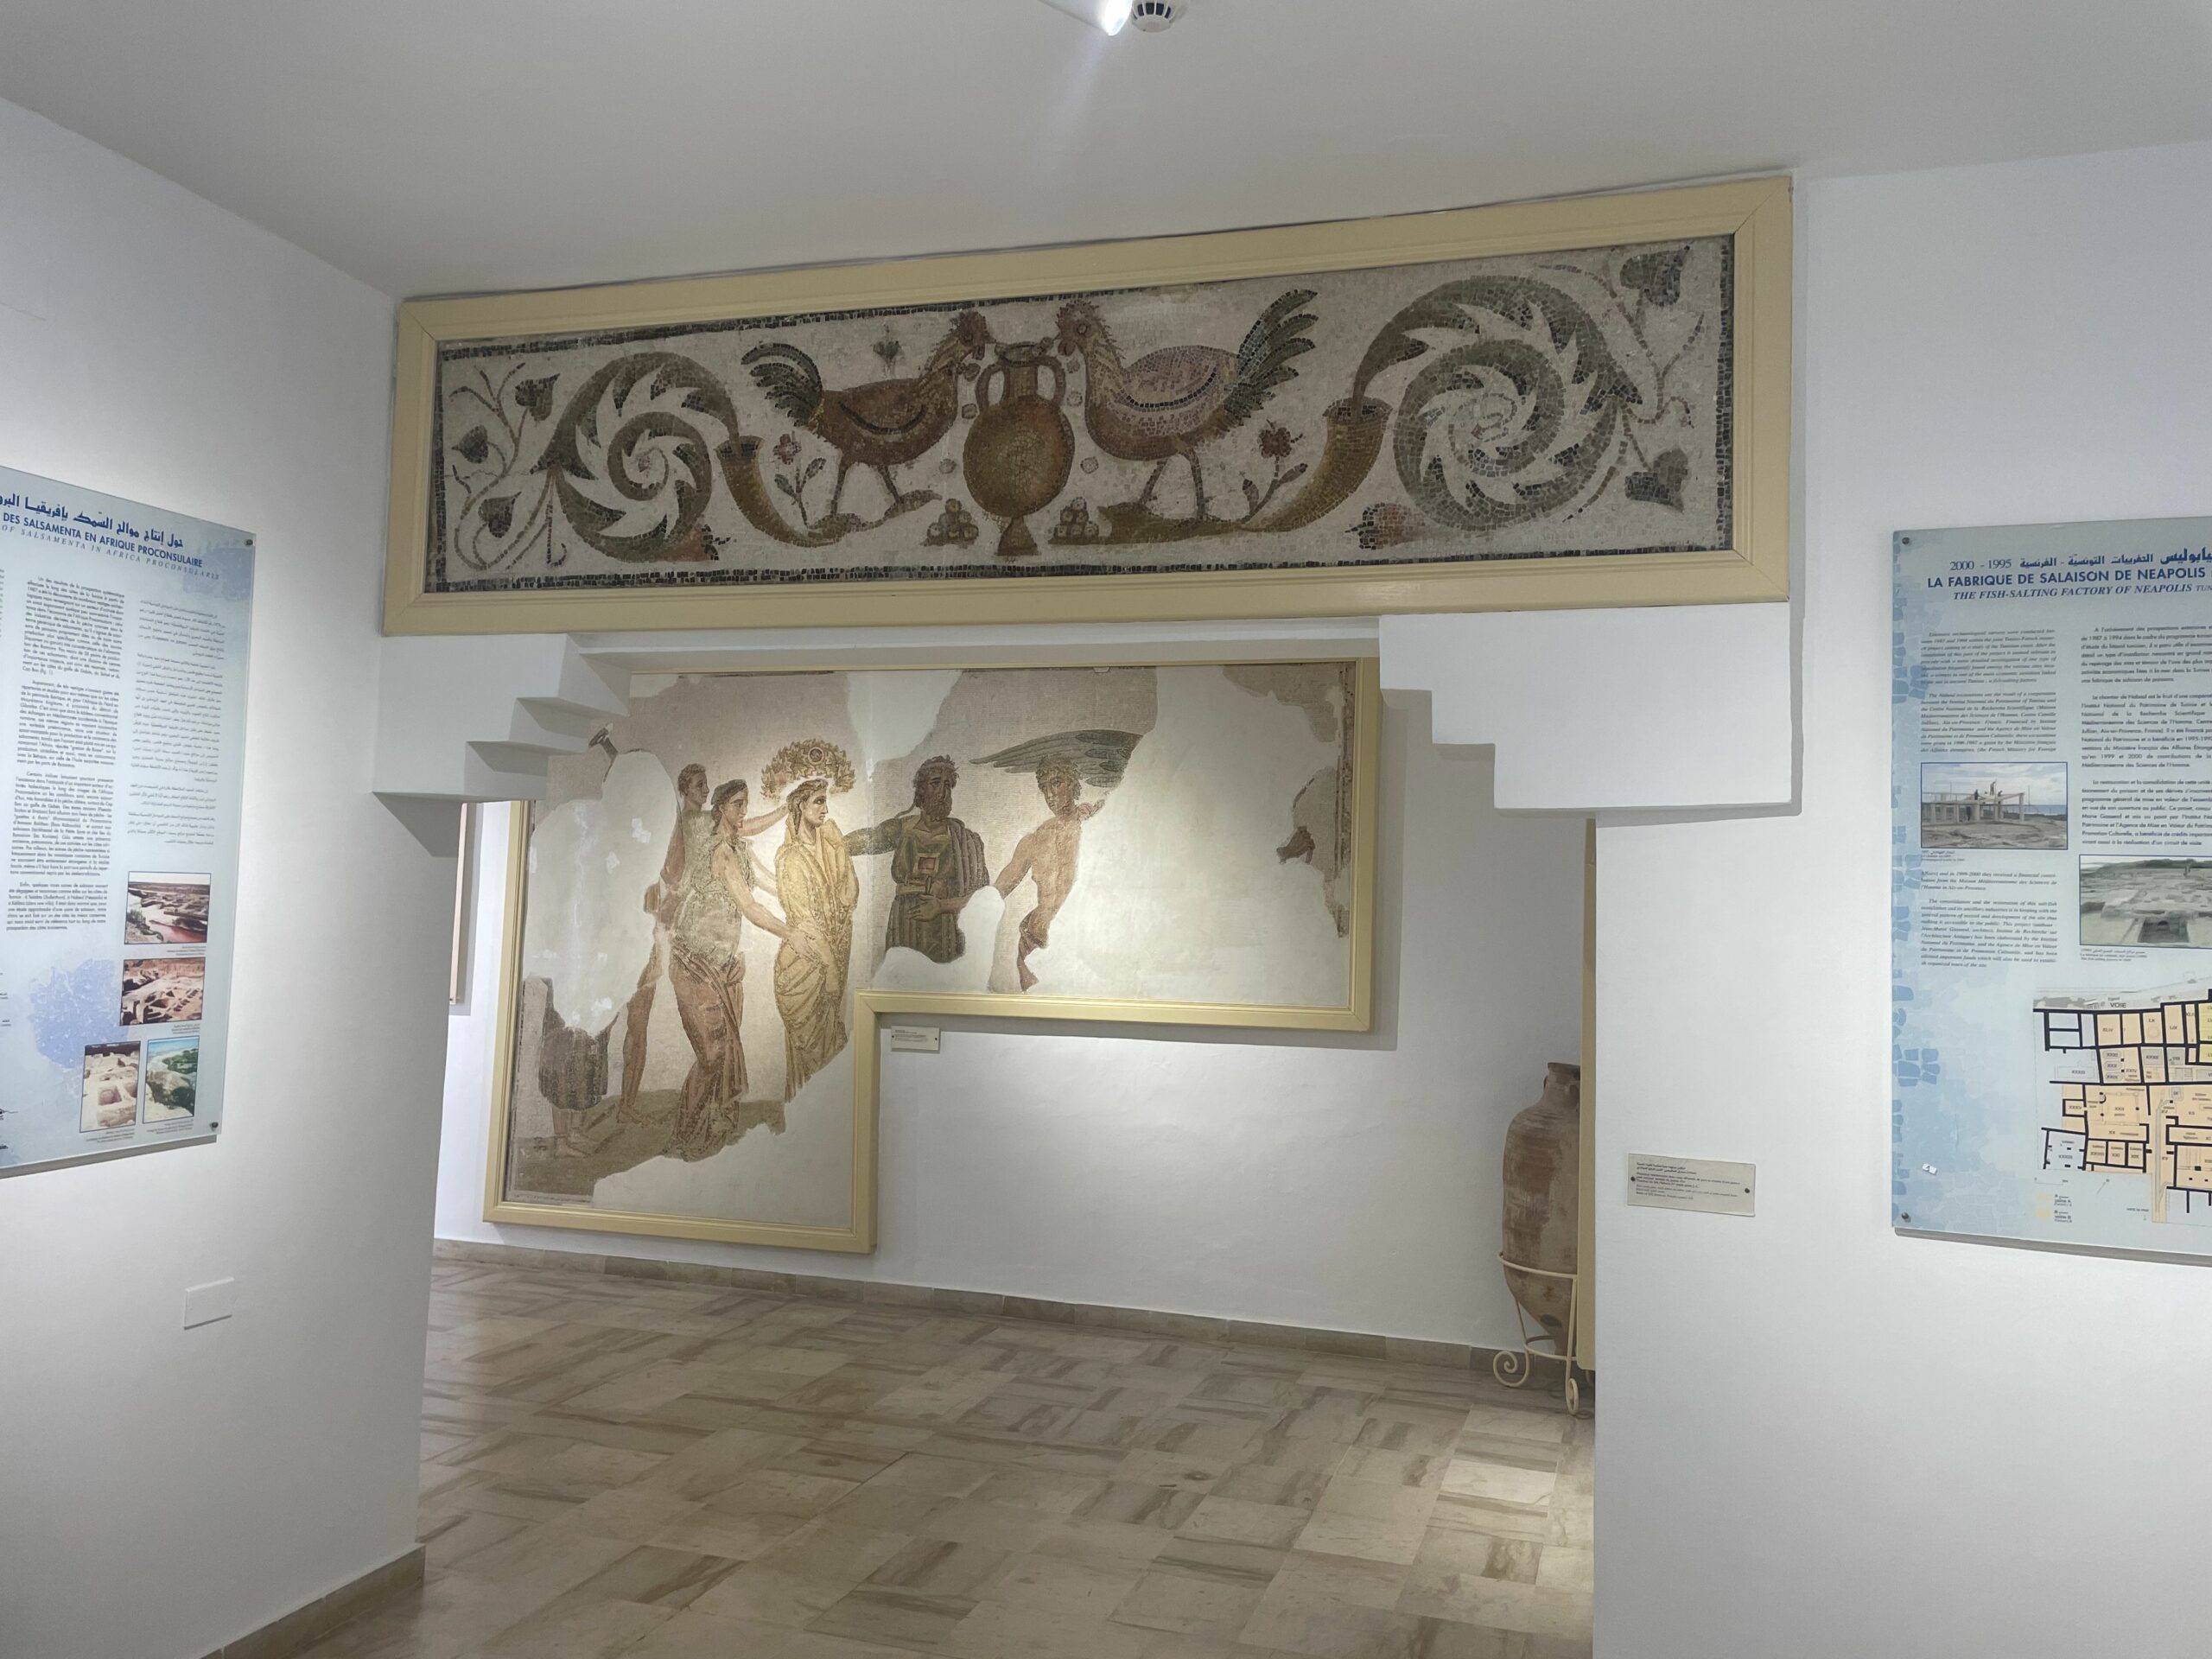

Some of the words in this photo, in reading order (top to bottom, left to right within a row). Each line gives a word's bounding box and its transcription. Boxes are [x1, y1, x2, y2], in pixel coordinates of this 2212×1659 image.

[3, 512, 20, 524] DES
[24, 517, 81, 539] SALSAMENTA
[85, 532, 96, 543] EN
[99, 536, 135, 551] AFRIQUE
[138, 544, 202, 567] PROCONSULAIRE
[21, 529, 86, 550] SALSAMENTA
[106, 550, 140, 562] AFRICA
[168, 534, 183, 548] حول
[1949, 561, 1974, 570] 2000
[1988, 559, 2012, 569] 1995
[1928, 577, 1942, 588] LA
[1948, 575, 2012, 588] FABRIQUE
[2018, 574, 2034, 584] DE
[2040, 570, 2109, 583] SALAISON
[2115, 569, 2132, 581] DE
[2138, 568, 2205, 580] NEAPOLIS
[1980, 588, 2058, 599] FISH-SALTING
[2061, 587, 2113, 596] FACTORY
[2133, 584, 2192, 594] NEAPOLIS
